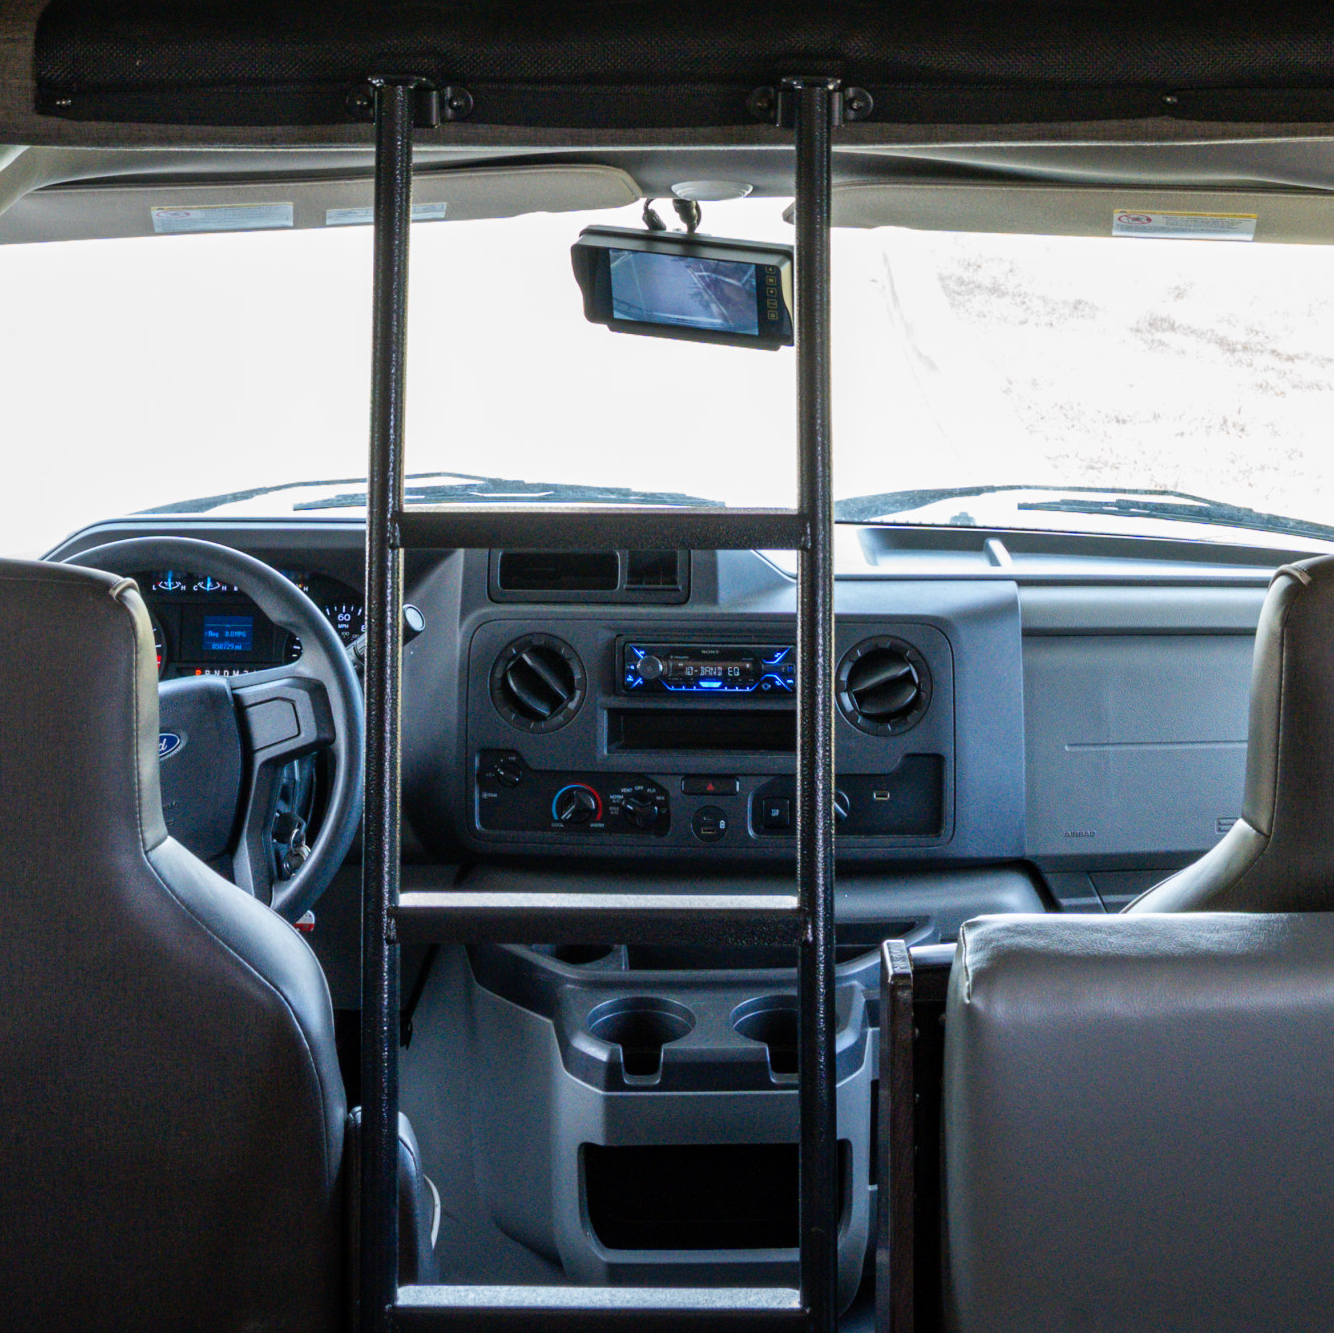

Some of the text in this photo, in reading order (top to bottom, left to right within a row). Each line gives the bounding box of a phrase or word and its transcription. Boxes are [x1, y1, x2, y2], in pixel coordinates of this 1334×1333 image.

[337, 613, 351, 621] 60
[685, 666, 740, 676] 10-BAND EQ
